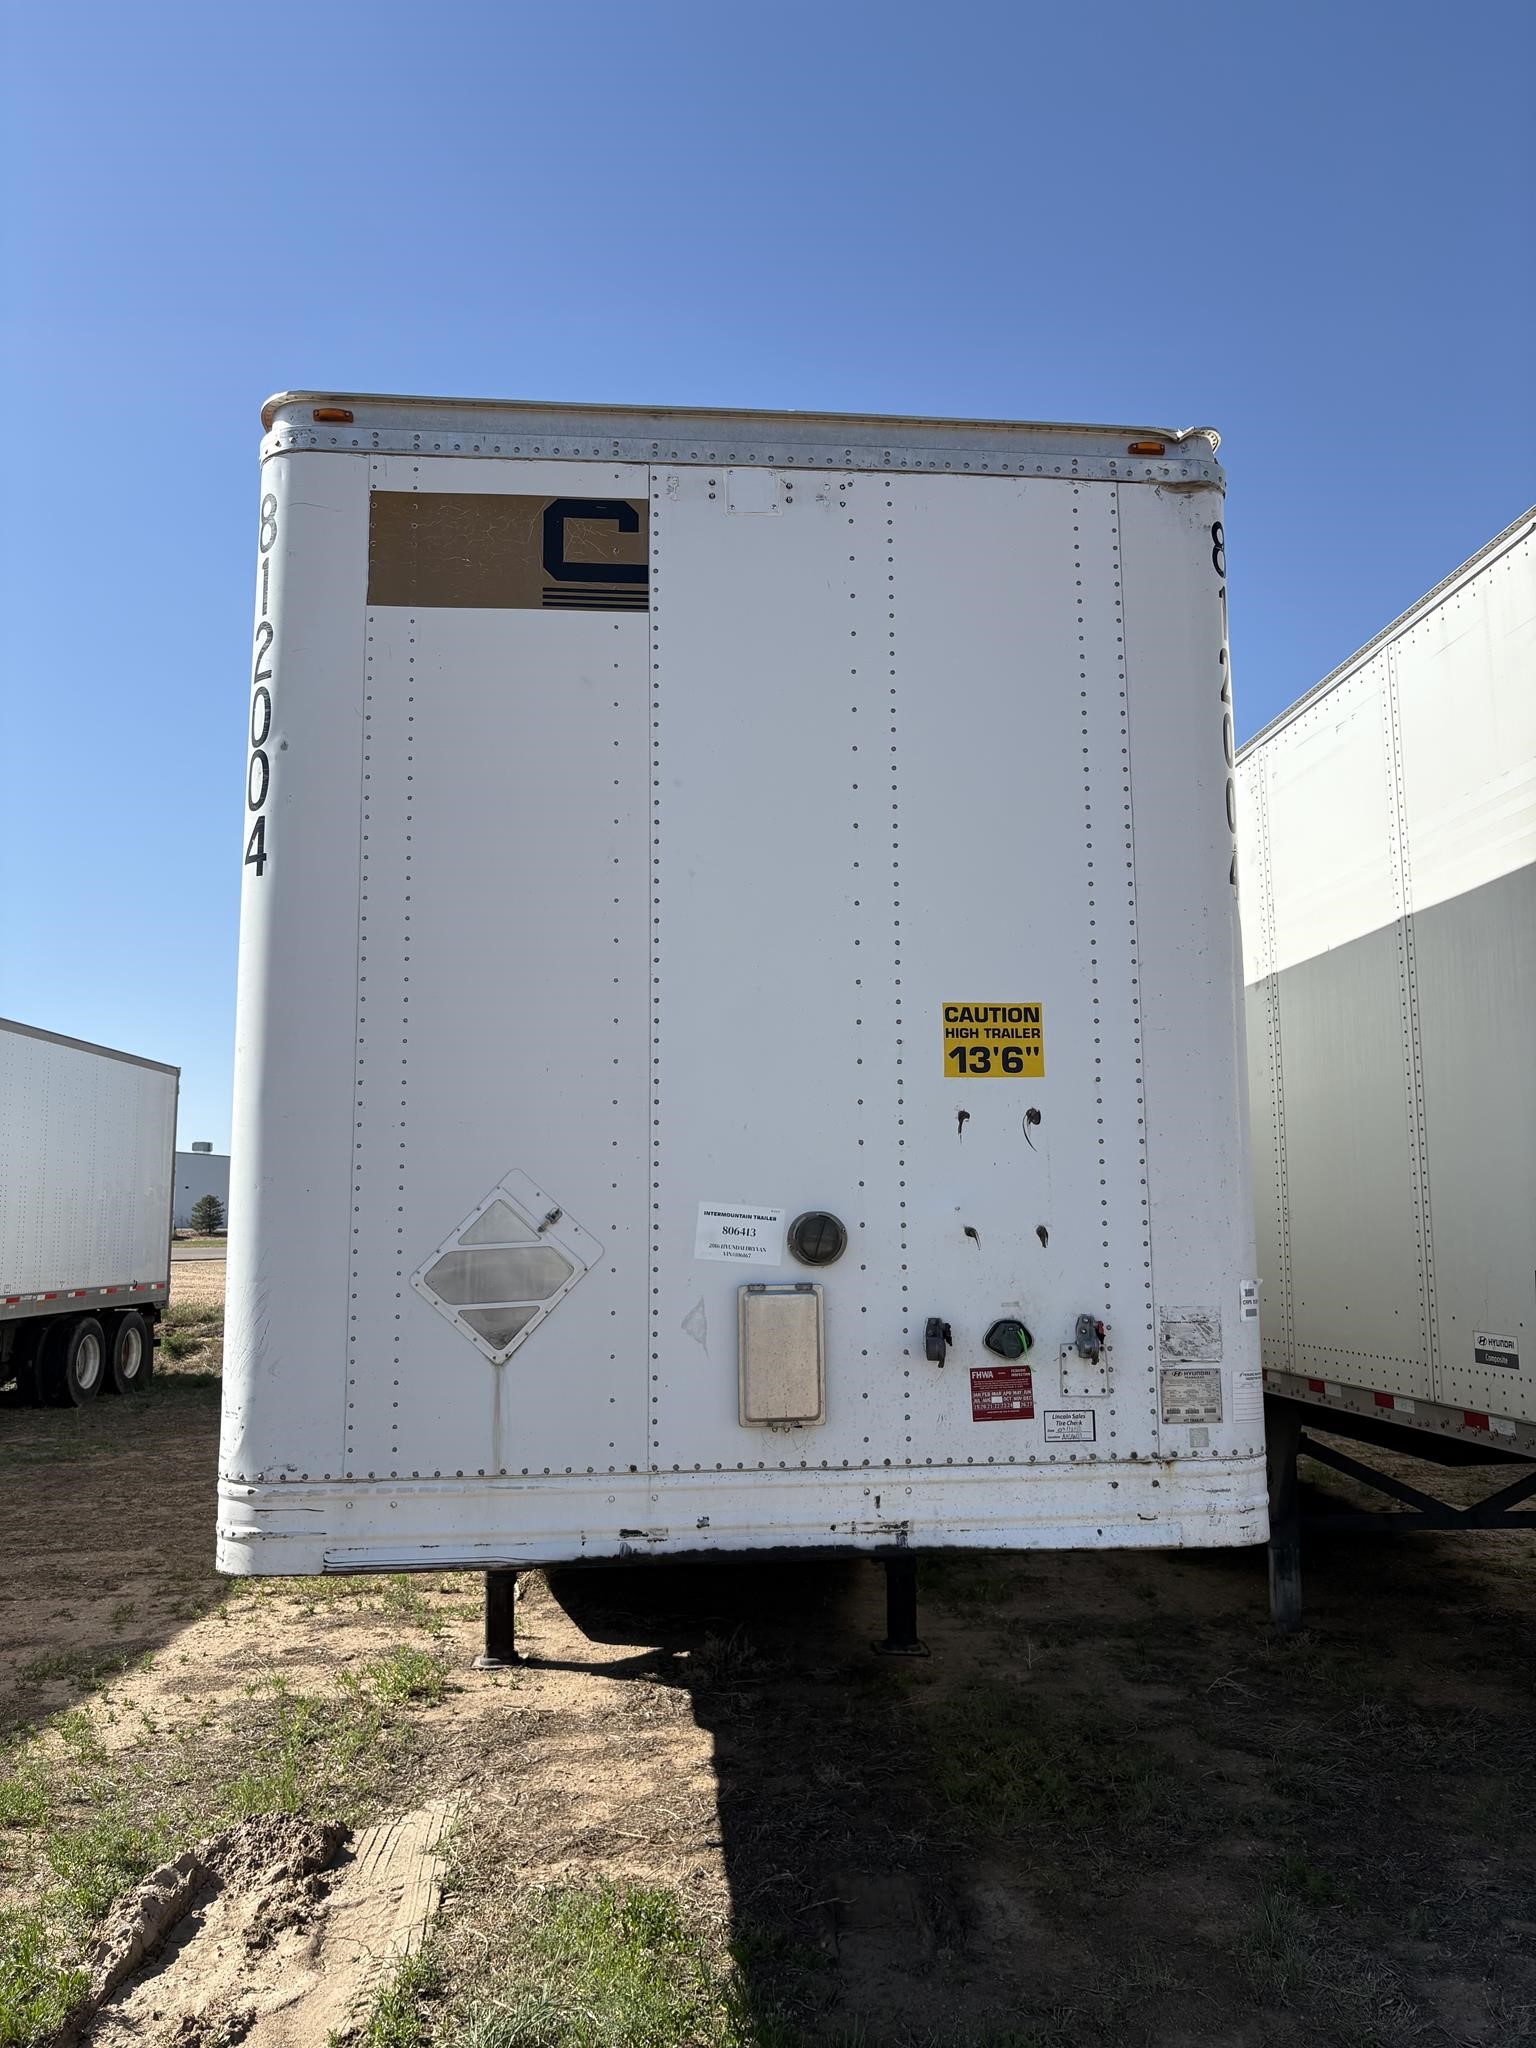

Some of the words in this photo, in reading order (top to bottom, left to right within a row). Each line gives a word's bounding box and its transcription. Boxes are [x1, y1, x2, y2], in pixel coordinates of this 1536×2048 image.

[244, 493, 278, 877] 812004
[944, 1006, 1040, 1023] CAUTION
[945, 1027, 979, 1039] HIGH
[983, 1027, 1041, 1039] TRAILER
[948, 1046, 1040, 1073] 13'6"
[703, 1211, 752, 1219] INTERMOUNTAIN
[722, 1225, 757, 1238] 806413
[1488, 1338, 1515, 1350] HYUNDAI
[972, 1370, 993, 1379] FHWA
